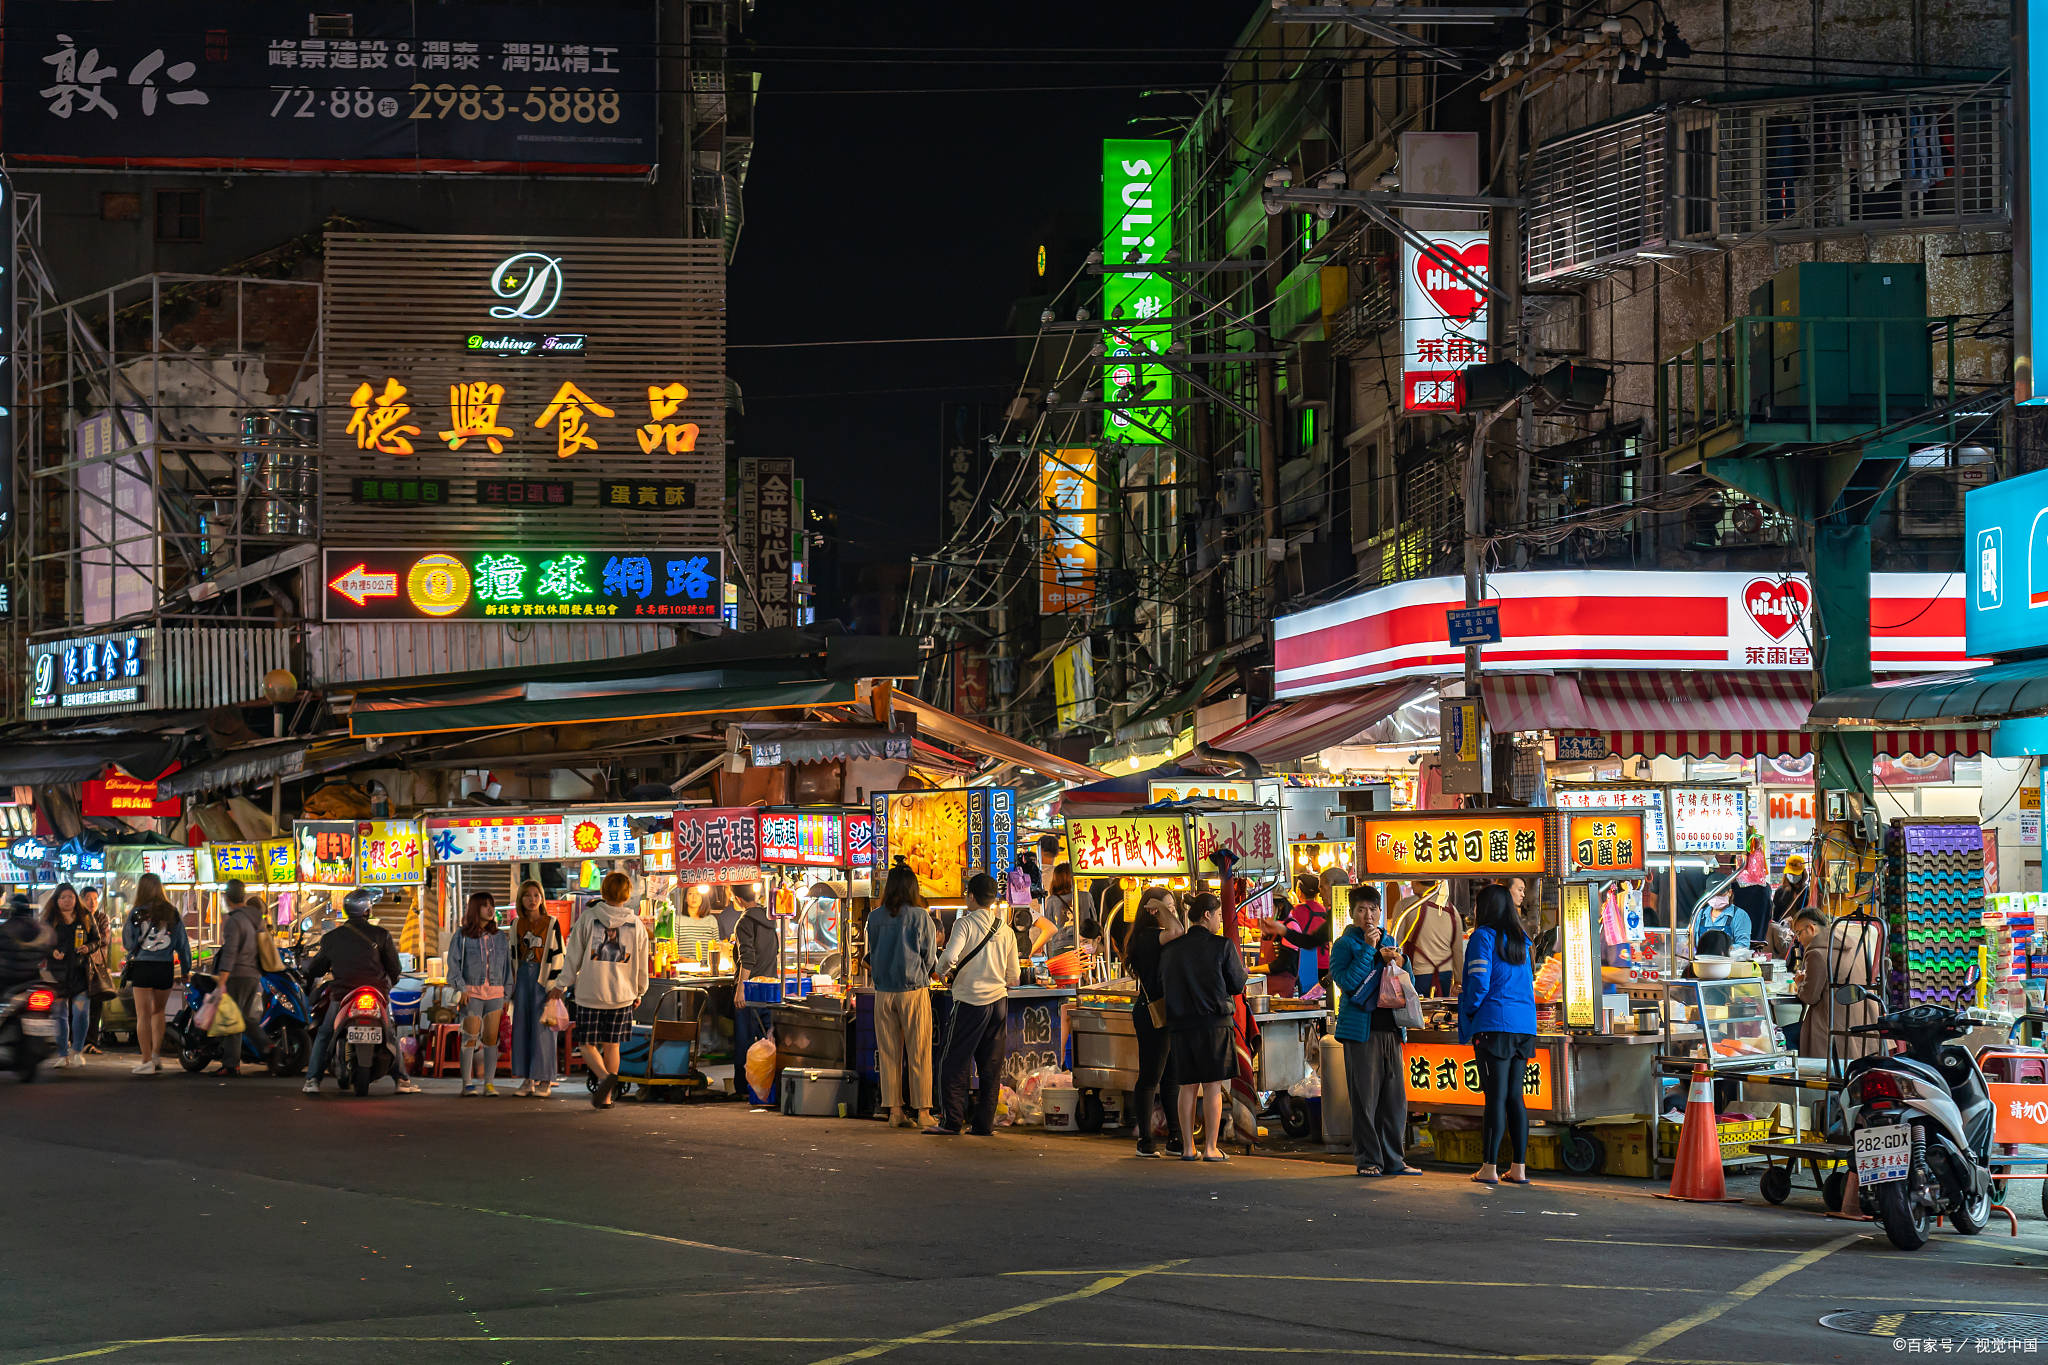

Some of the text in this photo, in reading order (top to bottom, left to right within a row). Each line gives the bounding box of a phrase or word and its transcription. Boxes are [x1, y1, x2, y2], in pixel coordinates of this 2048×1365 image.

[41, 34, 209, 119] 敦仁
[409, 84, 620, 124] 2983-5888
[468, 334, 583, 354] Dershing Food
[346, 377, 700, 458] 德興食品
[610, 485, 685, 506] 蛋黃酥
[1745, 646, 1809, 665] 萊爾富
[432, 829, 464, 860] 冰
[678, 815, 758, 865] 沙威瑪
[1592, 821, 1618, 838] 法式
[1413, 829, 1537, 864] 法式可麗餅
[1577, 838, 1633, 867] 可麗餅
[403, 872, 419, 880] 100
[1410, 1056, 1541, 1096] 法式可餅
